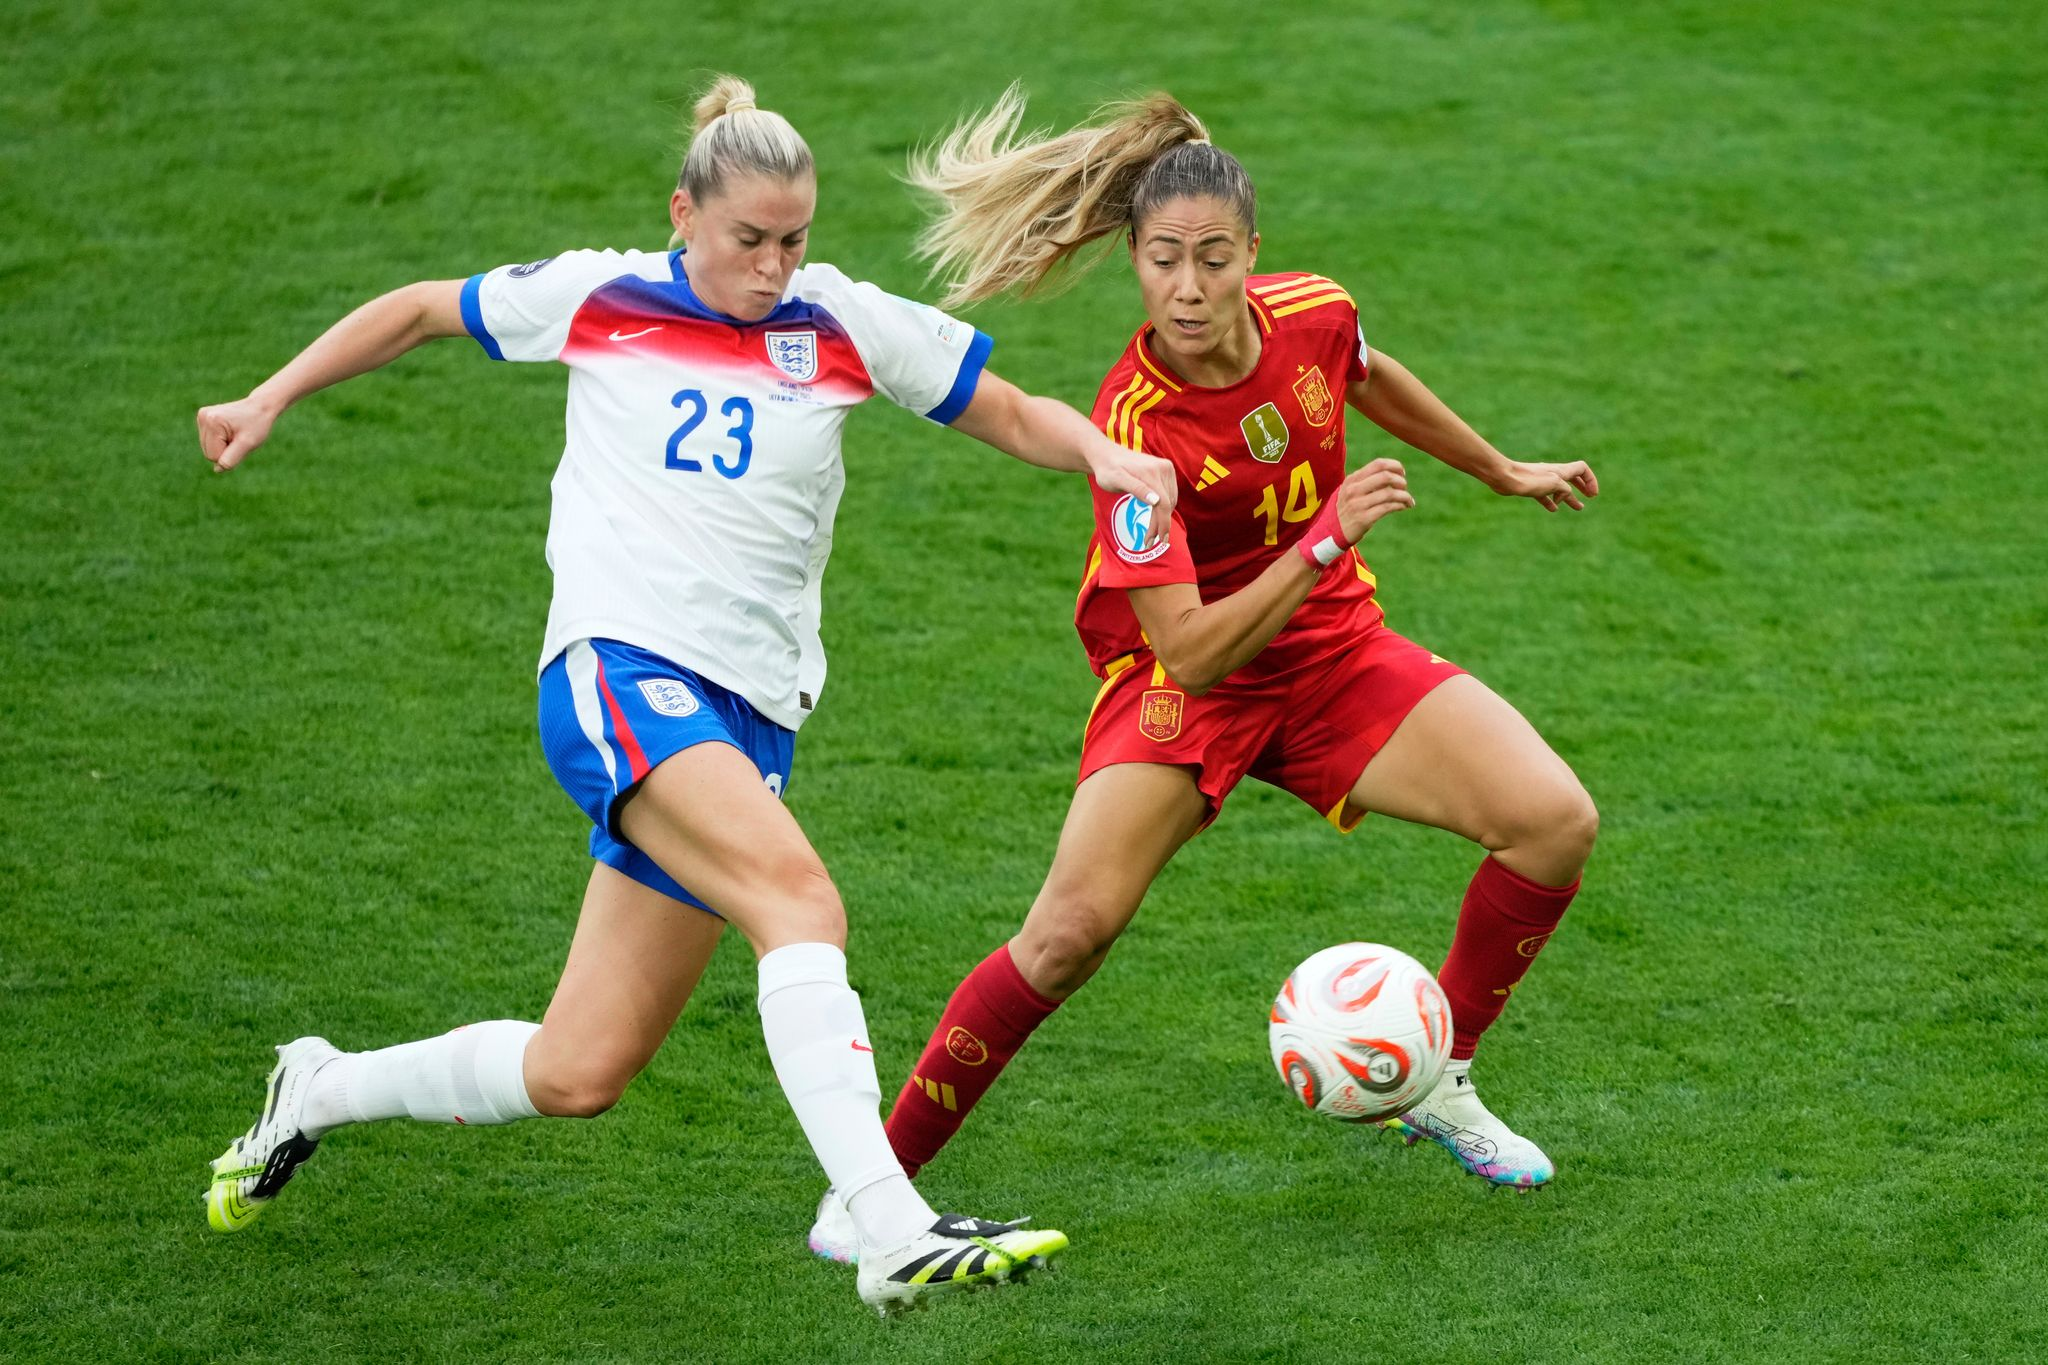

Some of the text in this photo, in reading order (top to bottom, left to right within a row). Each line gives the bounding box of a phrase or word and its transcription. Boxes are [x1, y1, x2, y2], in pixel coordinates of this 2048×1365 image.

[665, 389, 754, 479] 23
[1262, 438, 1281, 454] FIFA
[1253, 460, 1322, 546] 14
[1119, 549, 1154, 562] SWITZERLAND
